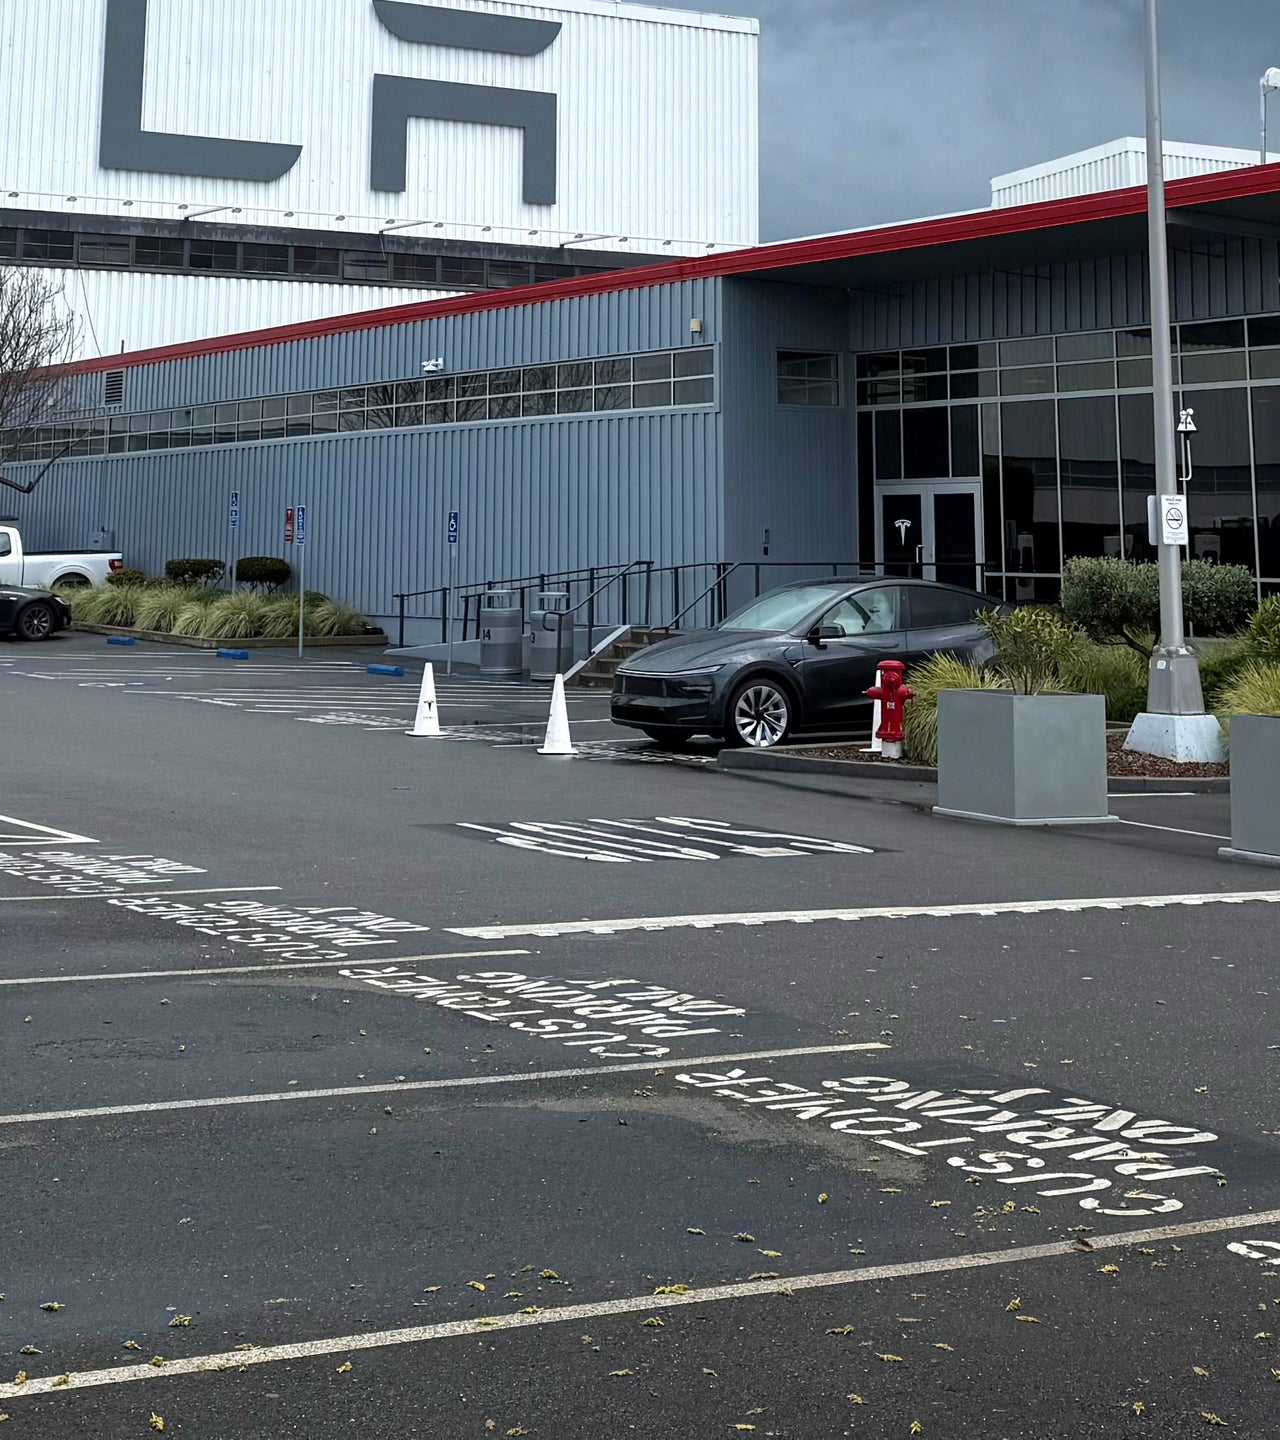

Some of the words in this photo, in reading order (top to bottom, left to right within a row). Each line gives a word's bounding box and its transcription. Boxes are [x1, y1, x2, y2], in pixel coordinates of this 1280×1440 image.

[482, 628, 491, 640] 14
[107, 897, 348, 960] CUSTOMER
[204, 900, 398, 947] PARKING
[294, 906, 430, 933] ONLY
[338, 966, 670, 1057] CUSTOMER
[456, 971, 721, 1038] PARKING
[565, 979, 746, 1016] ONLY
[674, 1068, 1184, 1215] CUSTOMER
[821, 1076, 1219, 1181] PARKING
[953, 1087, 1218, 1144] ONLY
